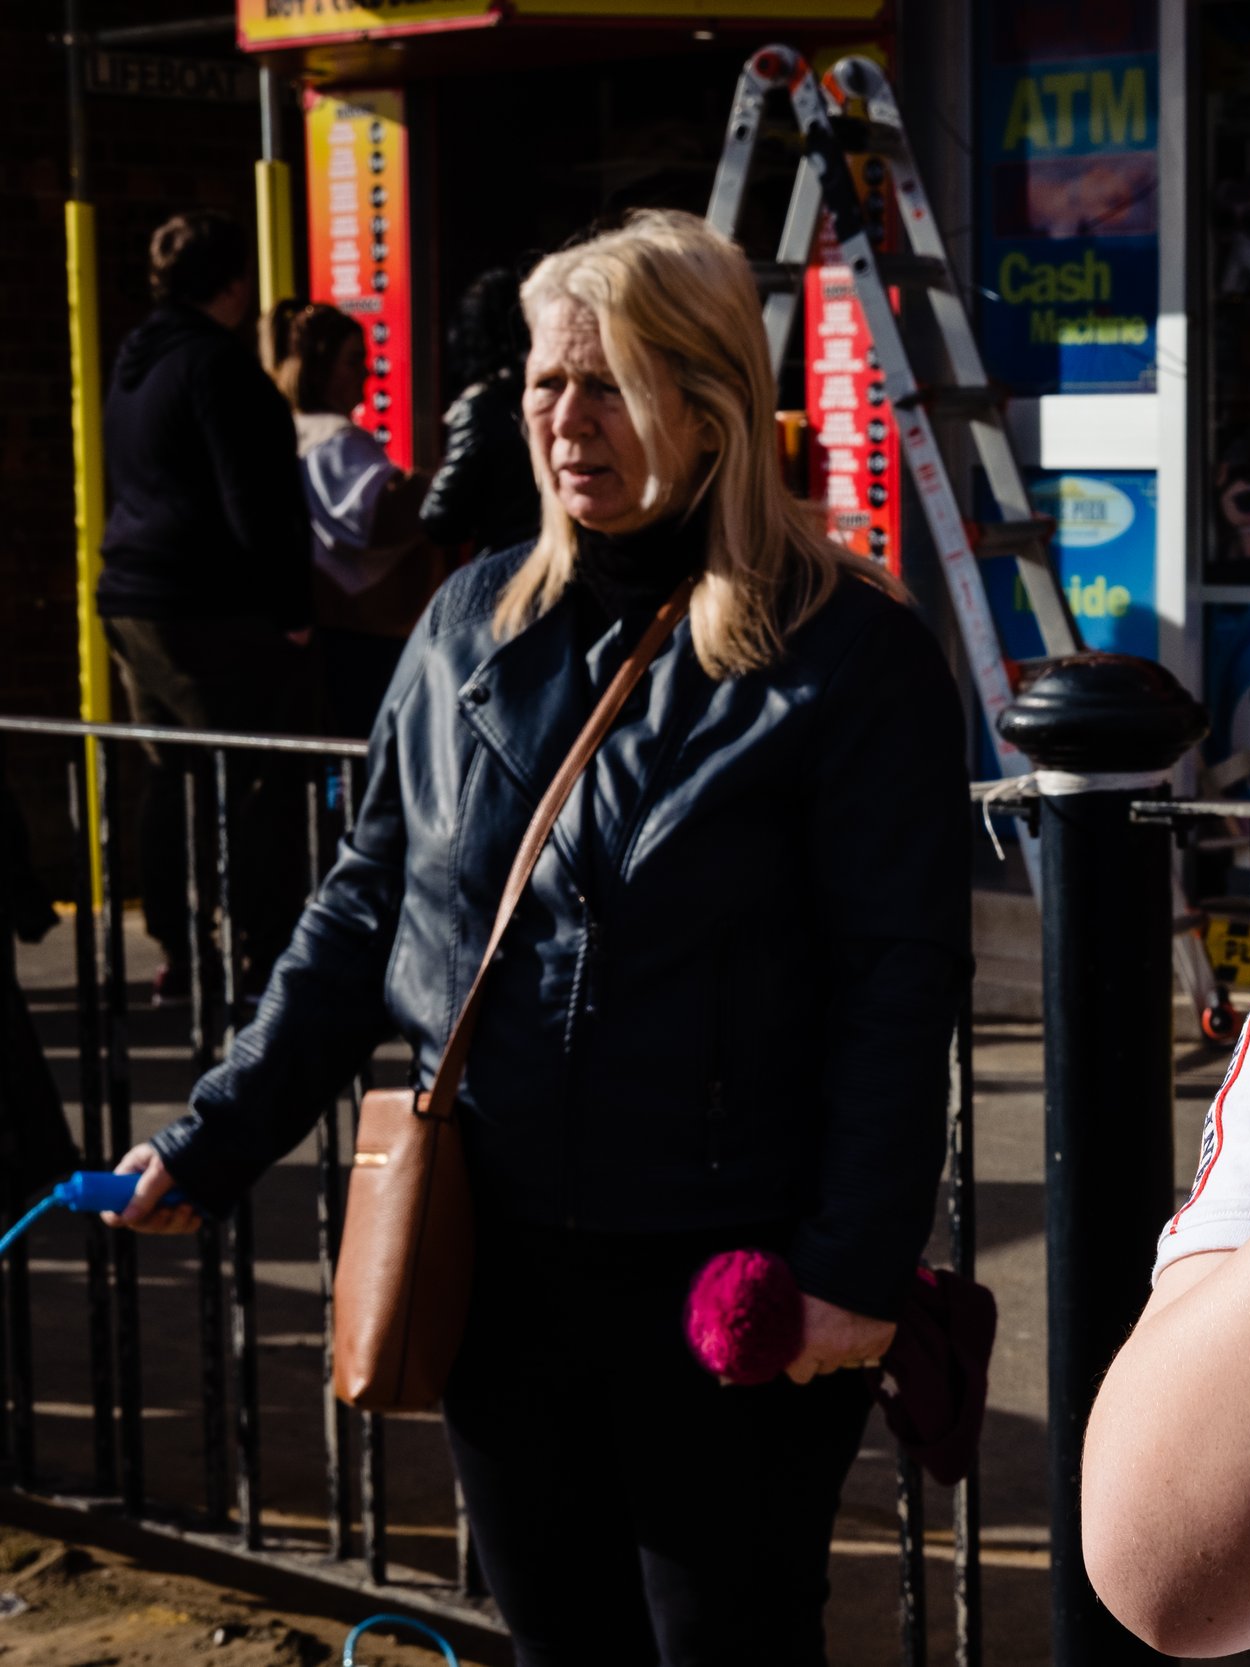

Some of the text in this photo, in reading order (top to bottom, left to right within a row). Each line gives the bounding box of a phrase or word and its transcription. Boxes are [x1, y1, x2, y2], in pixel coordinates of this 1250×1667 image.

[90, 53, 241, 99] LIFEBOAT
[1001, 66, 1148, 152] ATM
[999, 248, 1113, 304] Cash
[1029, 308, 1149, 346] Machine
